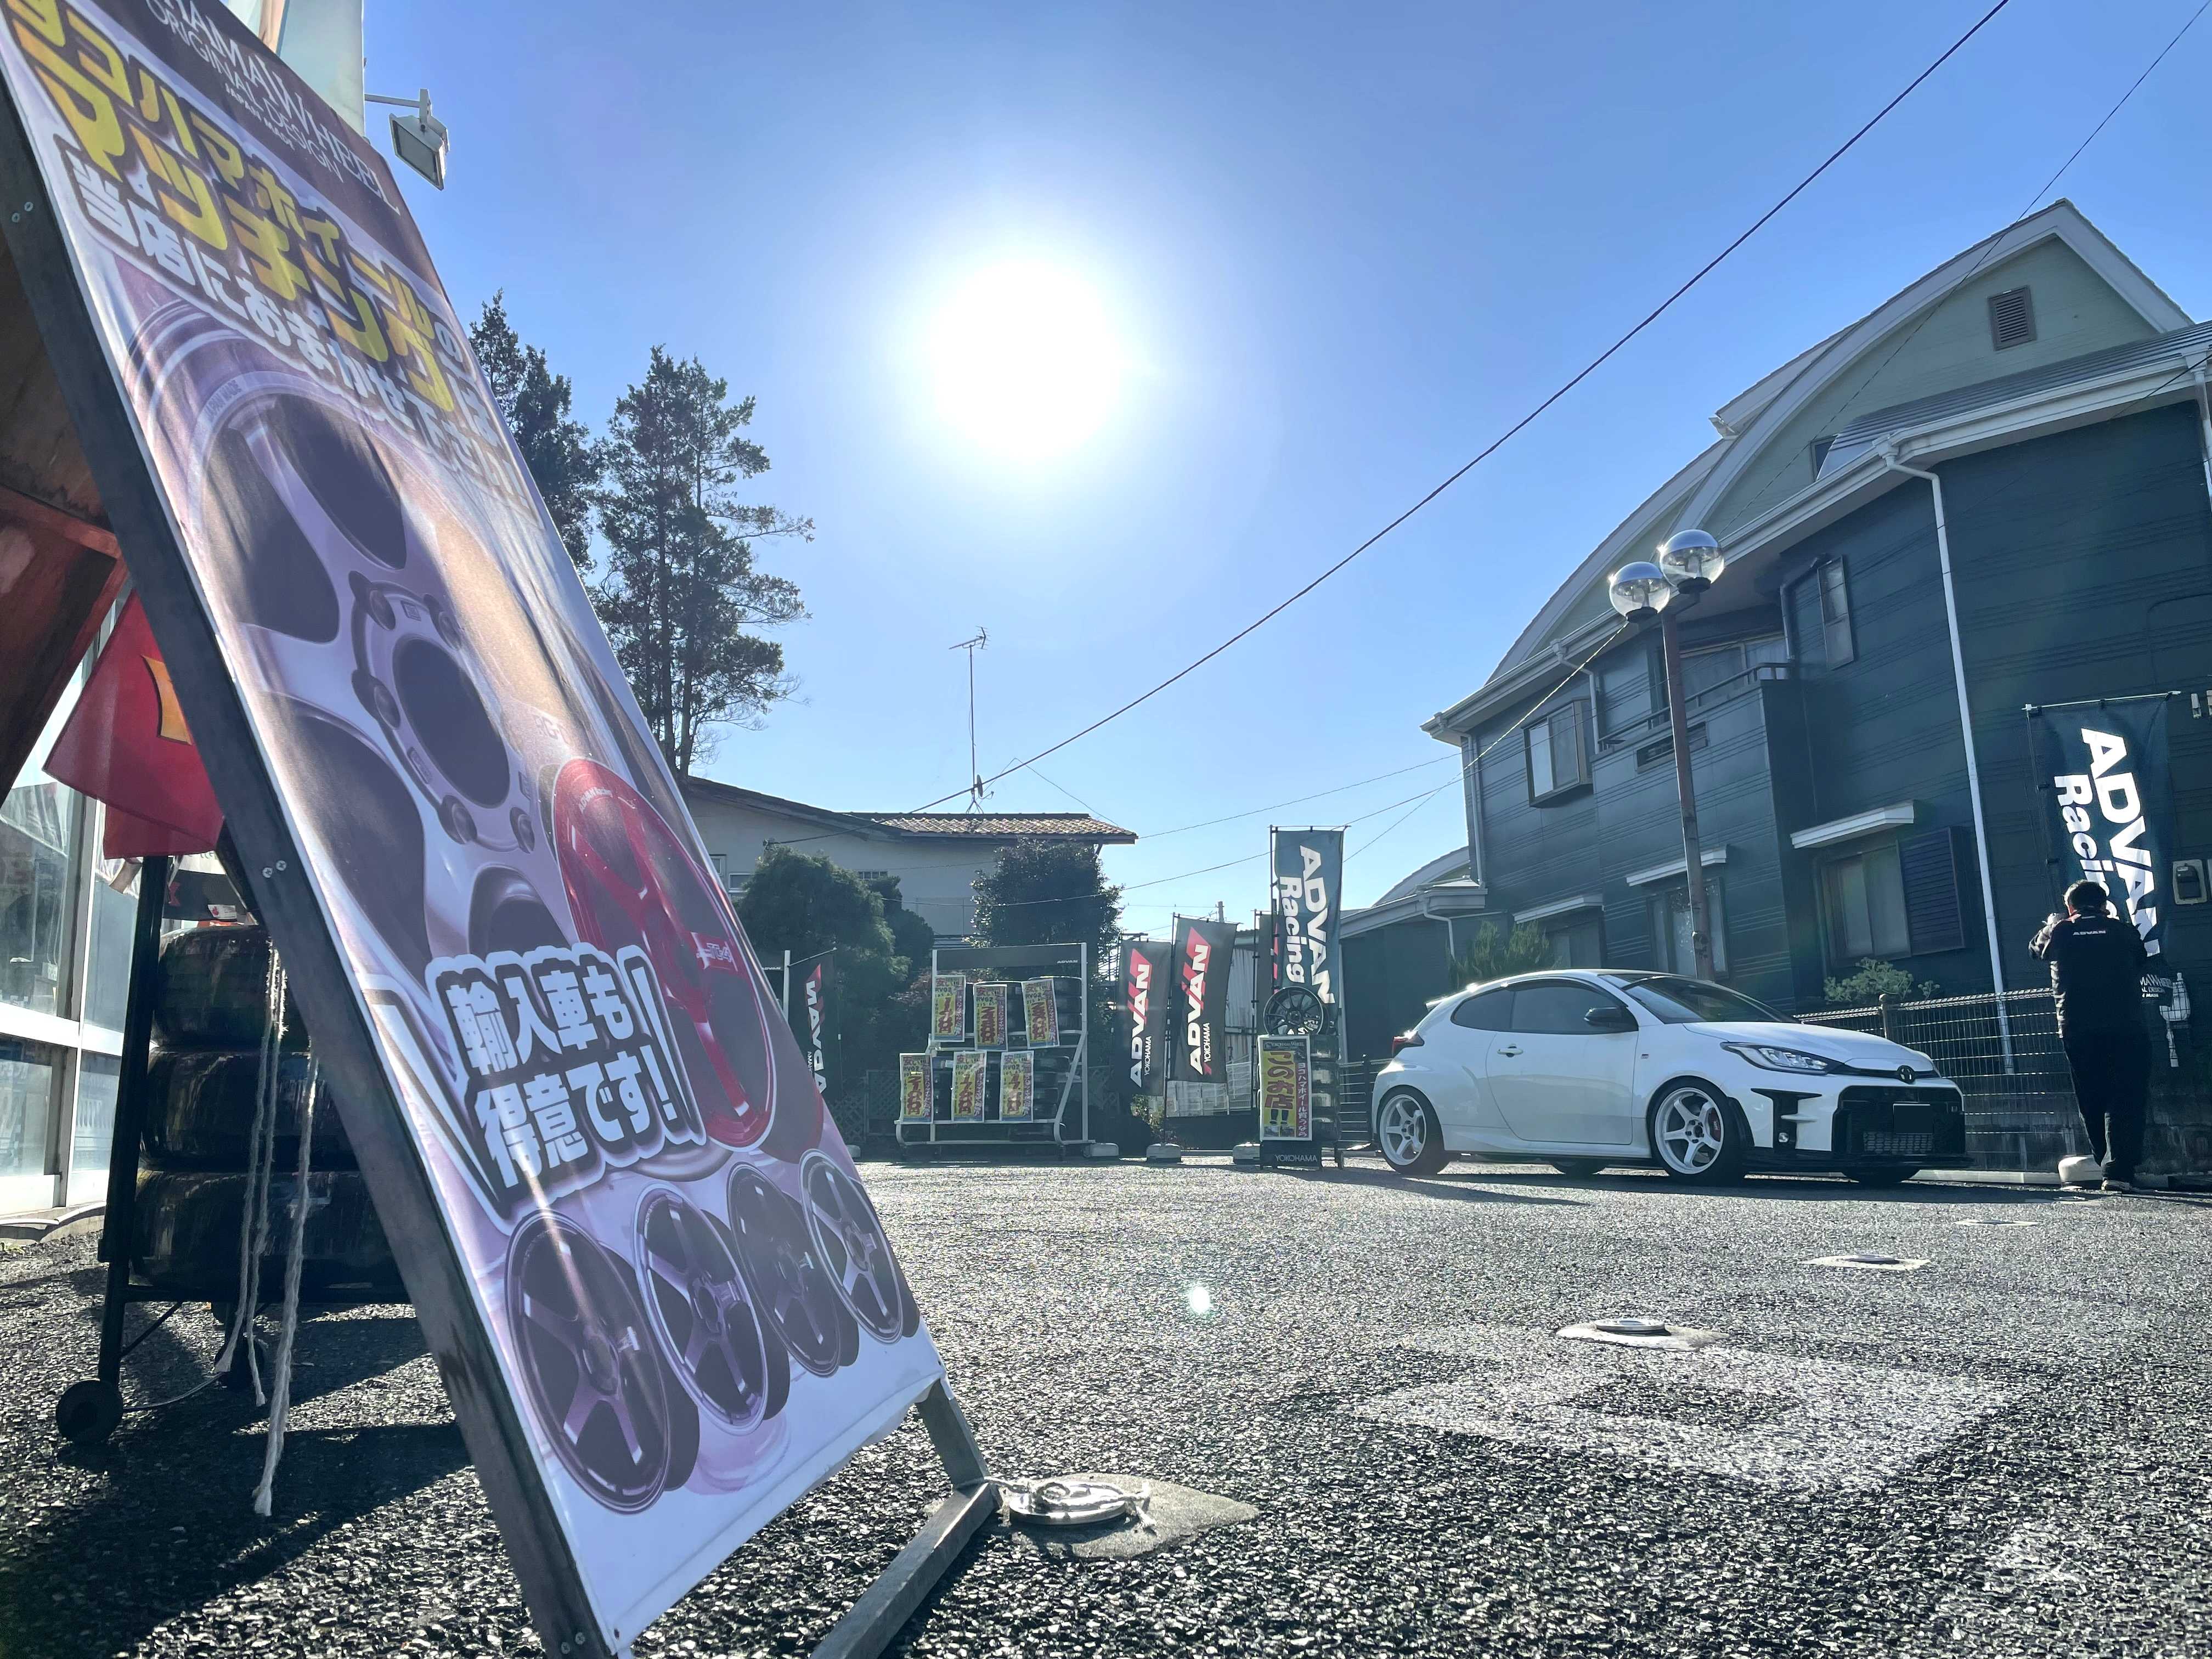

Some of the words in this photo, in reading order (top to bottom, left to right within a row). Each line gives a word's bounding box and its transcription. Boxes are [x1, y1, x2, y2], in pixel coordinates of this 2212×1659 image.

[146, 0, 264, 111] ORIGINAL
[262, 97, 343, 183] DESIGN
[1279, 876, 1305, 984] Racing
[1299, 845, 1335, 1005] ADVAN
[445, 966, 634, 1076] 輸入車も
[1130, 963, 1151, 1088] ADVAN
[1143, 1035, 1152, 1076] YOKOHAMA
[1188, 943, 1210, 1075] ADVAN
[473, 1044, 678, 1189] 得意です!
[1264, 1051, 1295, 1110] このお店
[1297, 1062, 1308, 1137] ヨコハマホイール買うなら
[1274, 1154, 1318, 1162] YOKOHAMA
